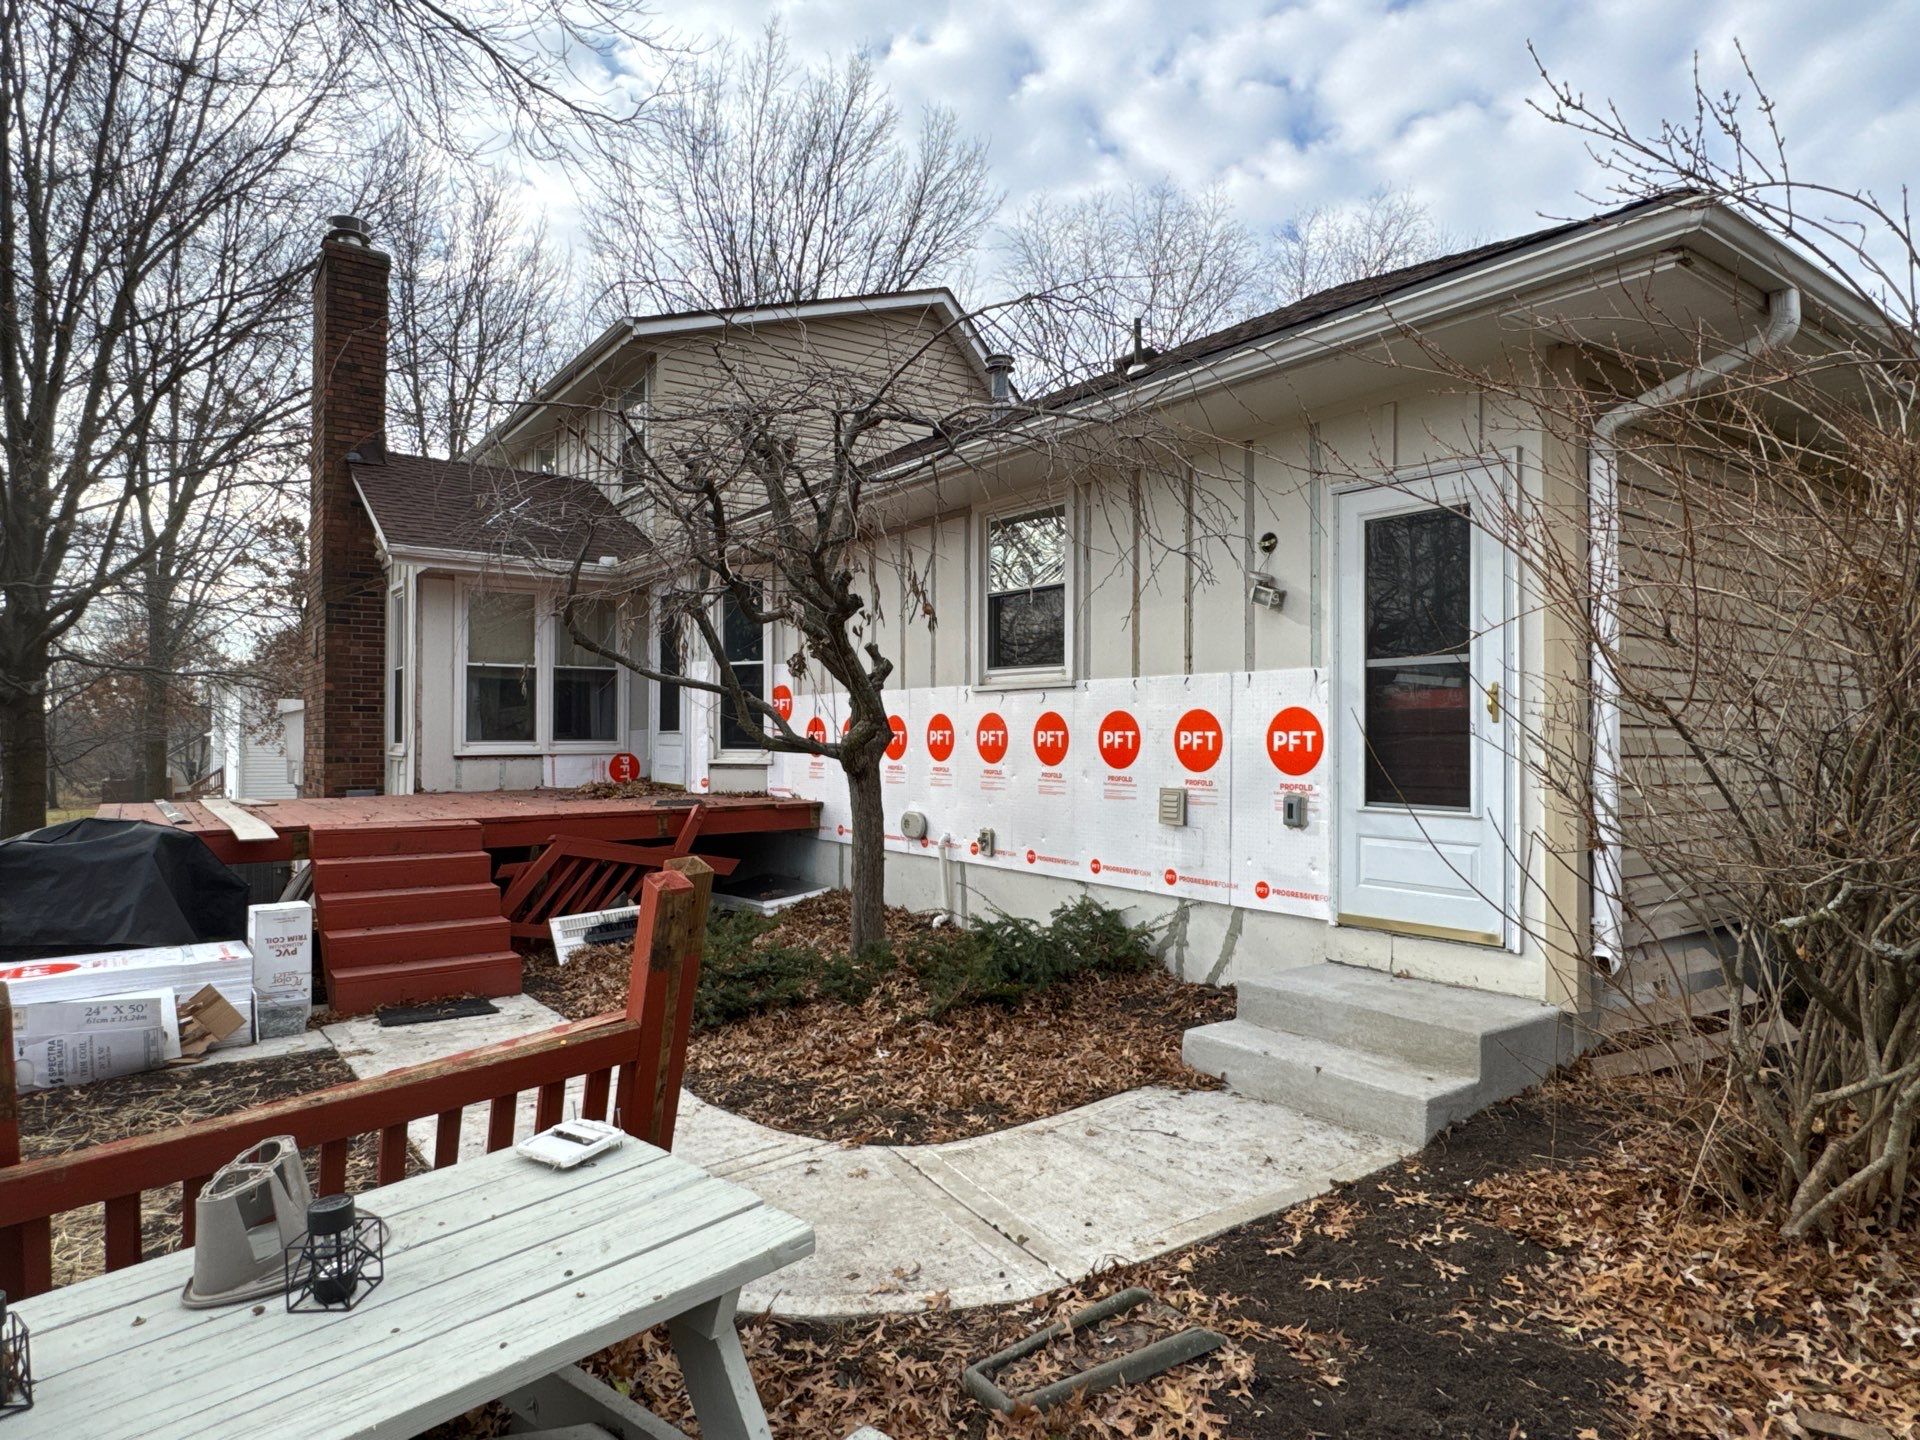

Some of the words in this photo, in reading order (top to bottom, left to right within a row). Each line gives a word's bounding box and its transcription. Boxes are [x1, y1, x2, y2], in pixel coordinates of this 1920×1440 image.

[892, 730, 905, 746] FT
[929, 730, 951, 746] PFT
[980, 730, 1004, 746] PFT
[1037, 730, 1065, 748] PFT
[1102, 730, 1136, 750] PFT
[1179, 730, 1217, 751] PFT
[1272, 730, 1317, 752] PFT
[620, 756, 631, 782] PFT
[1184, 778, 1214, 787] PROFOLD
[1279, 783, 1314, 791] PROFOLD
[1272, 888, 1332, 903] PROGRESSIVEFO
[265, 936, 286, 944] COIL
[287, 935, 307, 943] TRIM
[275, 948, 298, 957] PVC
[113, 1005, 124, 1015] X
[128, 1003, 148, 1013] 50'
[48, 1040, 57, 1078] SPECTRA
